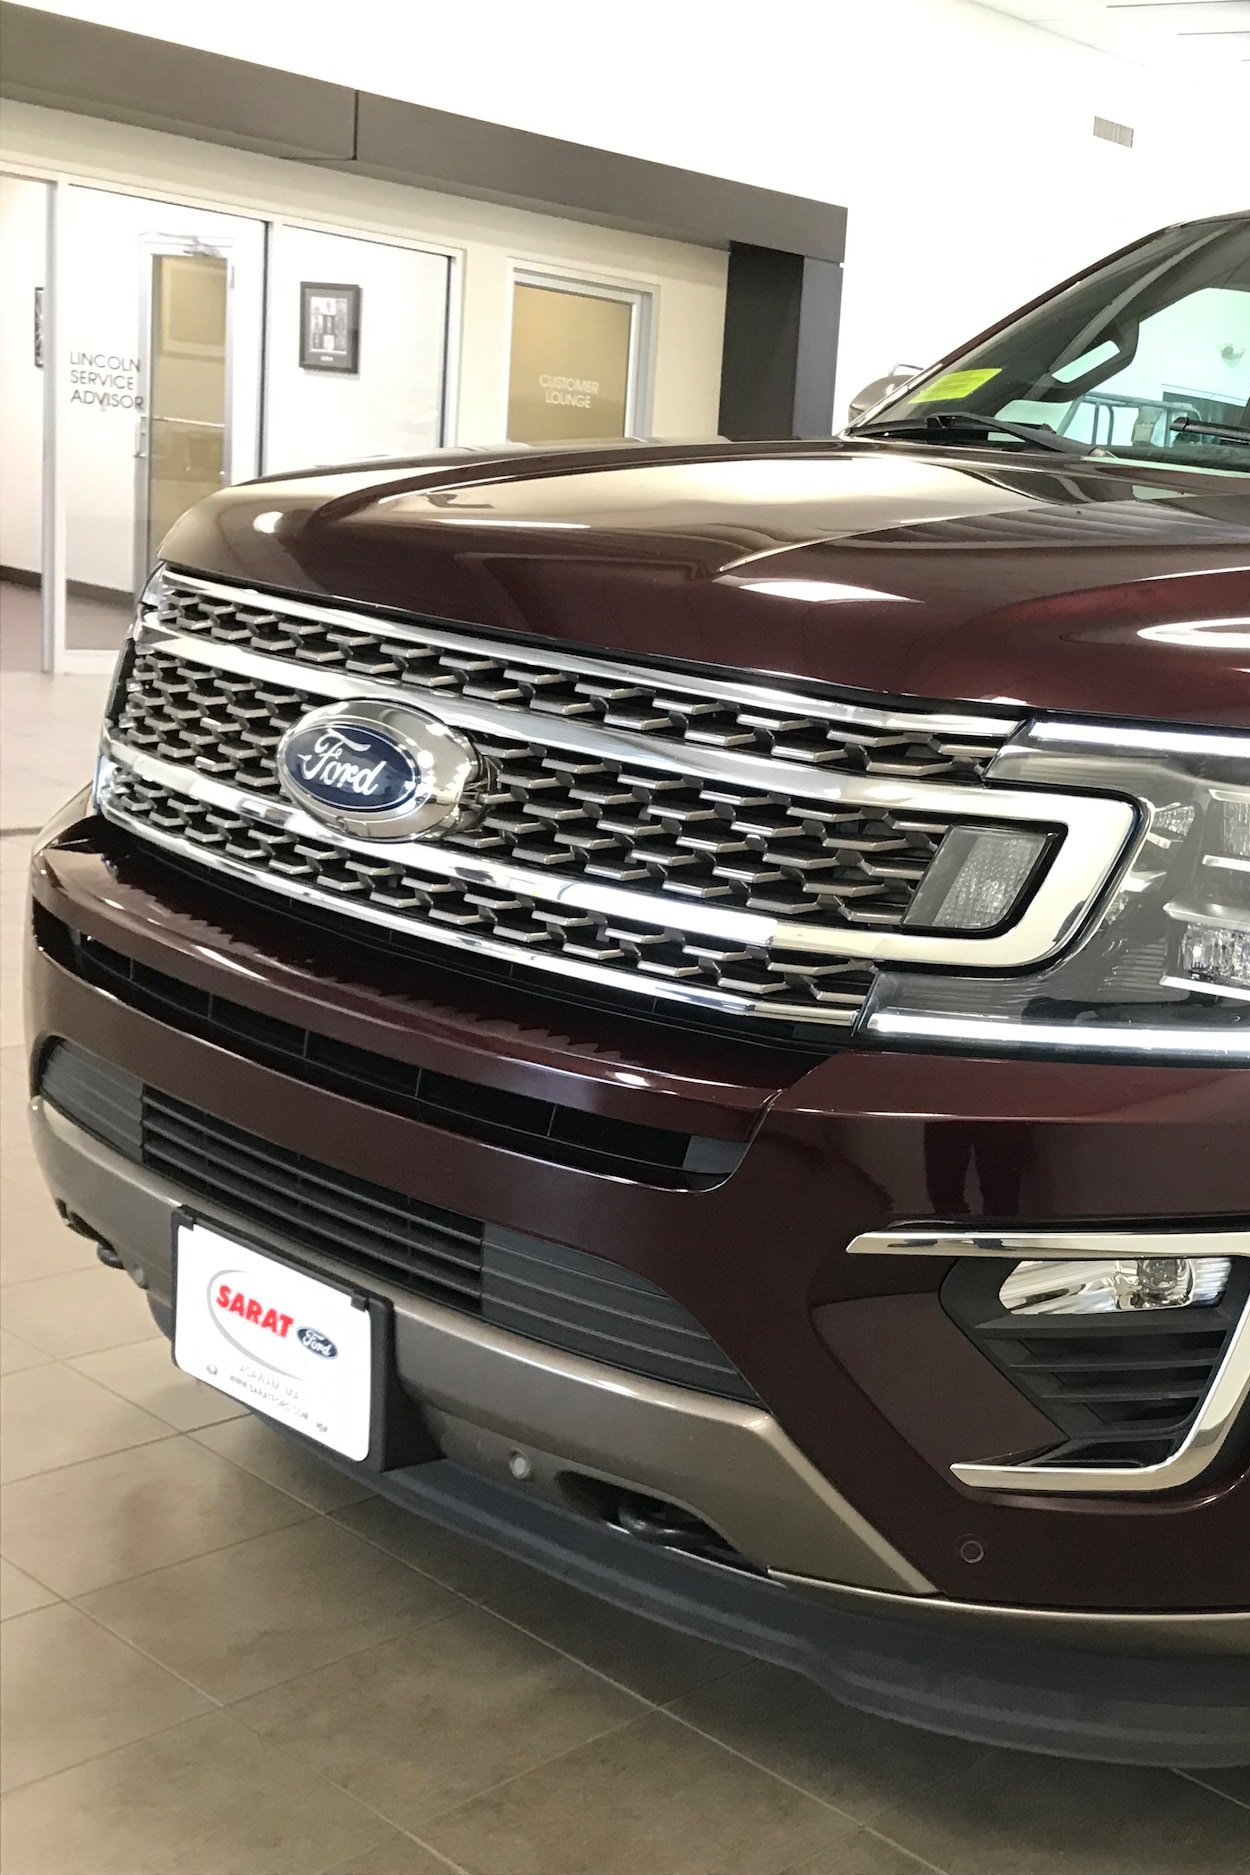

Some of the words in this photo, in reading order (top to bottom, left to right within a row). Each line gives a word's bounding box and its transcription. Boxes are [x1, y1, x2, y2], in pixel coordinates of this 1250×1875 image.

[70, 351, 141, 372] LINCOLN
[70, 369, 134, 390] SERVICE
[539, 374, 599, 394] CUSTOMER
[70, 389, 144, 410] ADVISOR
[545, 391, 591, 409] LOUNGE
[297, 727, 388, 796] Ford
[215, 1284, 295, 1339] SARAT
[301, 1328, 333, 1357] Ford
